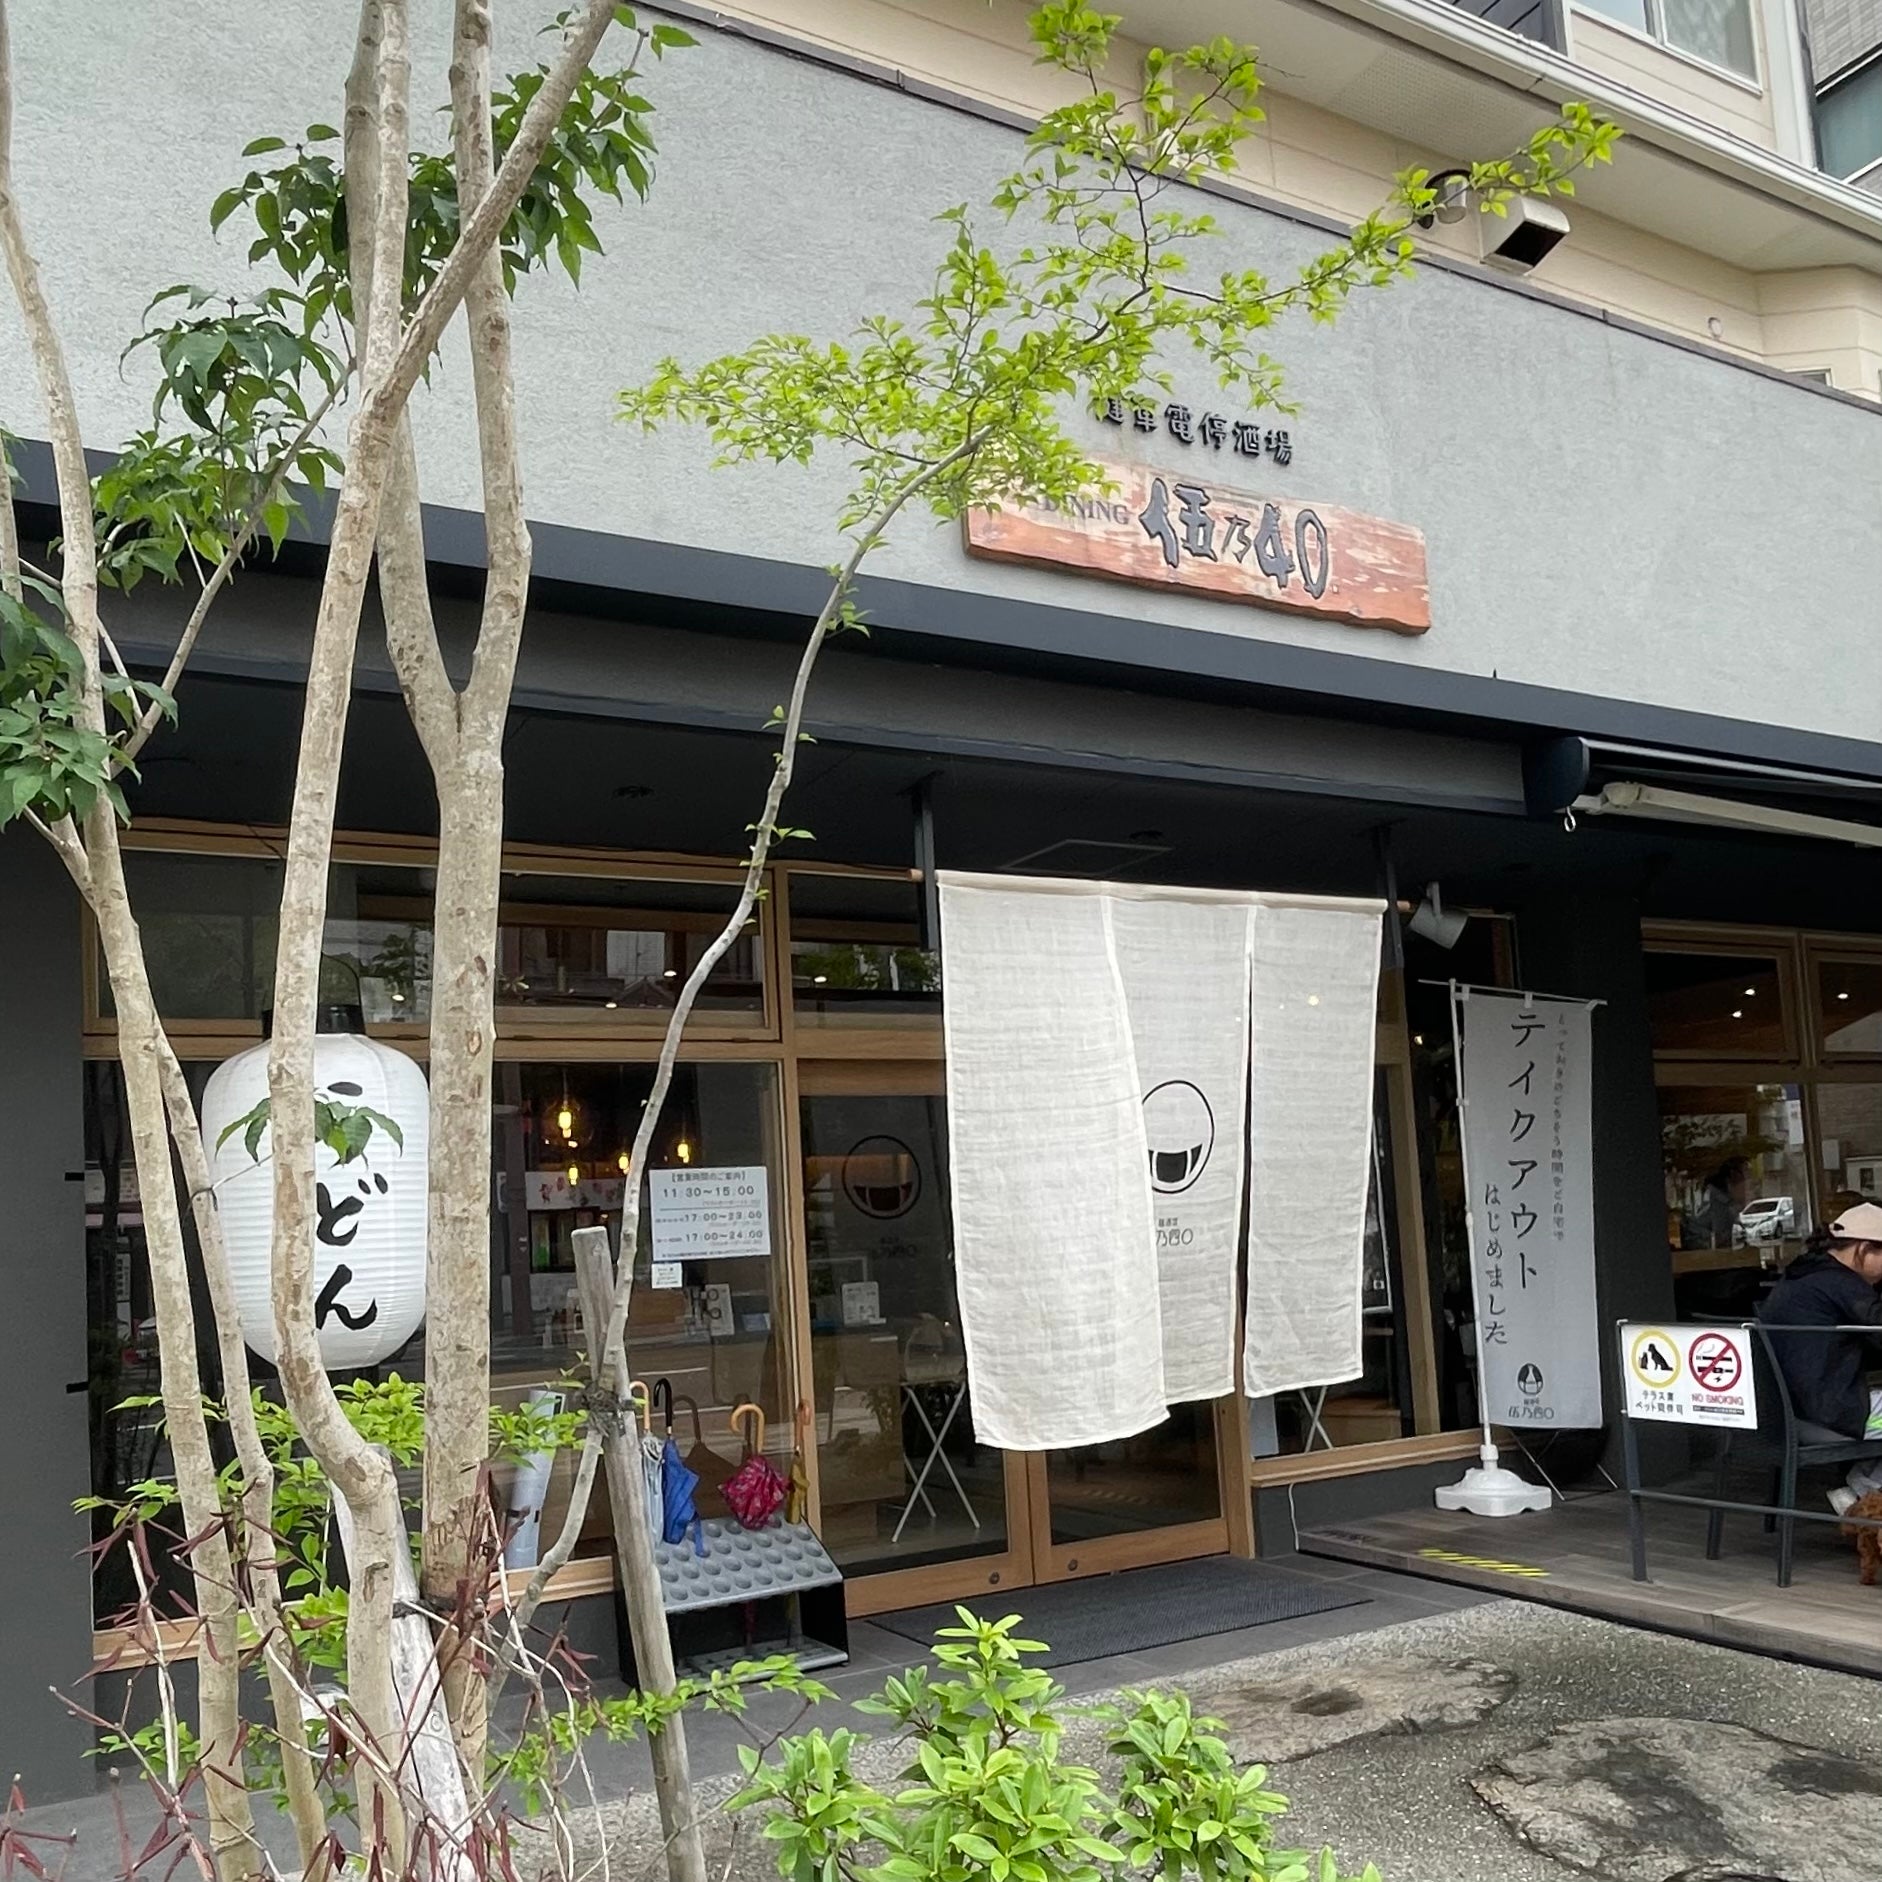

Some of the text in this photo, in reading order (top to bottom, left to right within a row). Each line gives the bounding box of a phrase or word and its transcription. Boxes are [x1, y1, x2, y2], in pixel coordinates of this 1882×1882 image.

[1036, 490, 1131, 525] DNING
[312, 1080, 389, 1331] どん
[1507, 1013, 1546, 1290] テイクアウト
[1483, 1182, 1508, 1345] はじめました
[1691, 1392, 1745, 1407] NO SMOKING
